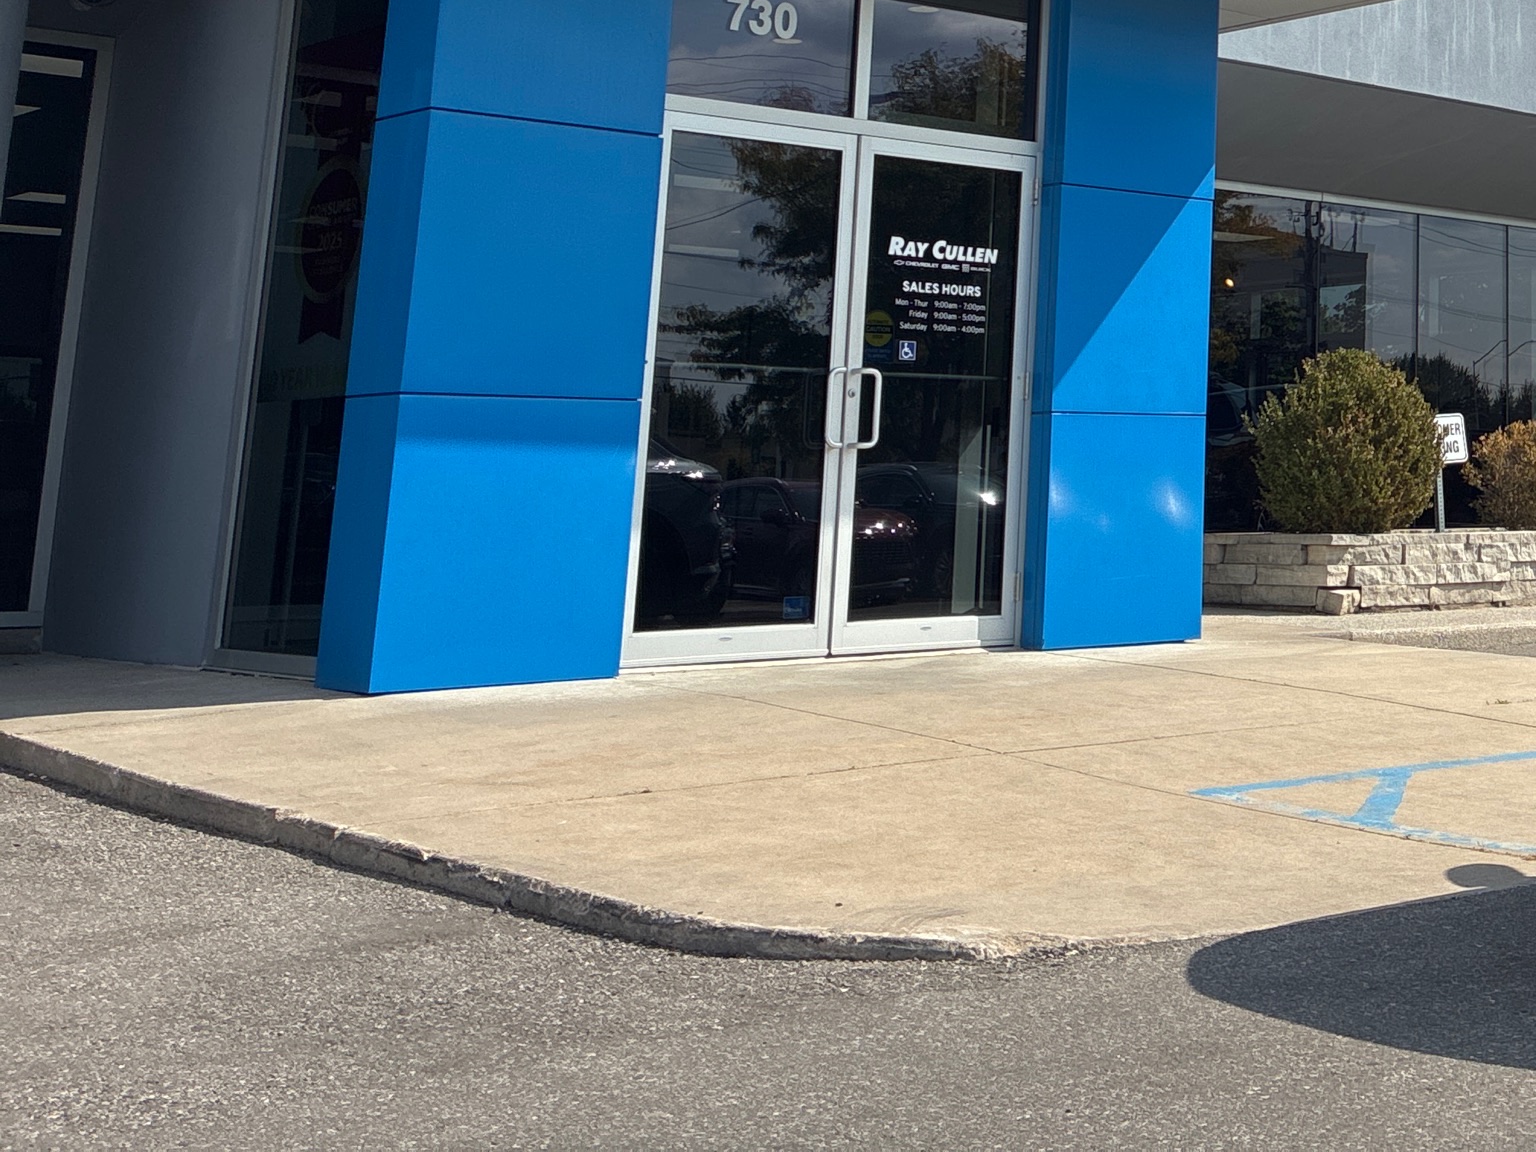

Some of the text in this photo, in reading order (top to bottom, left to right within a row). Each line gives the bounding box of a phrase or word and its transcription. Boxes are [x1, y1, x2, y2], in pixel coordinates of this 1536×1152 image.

[888, 236, 999, 264] RAY CULLEN
[905, 261, 939, 269] CHEVROLET
[941, 263, 960, 271] GMC
[902, 281, 982, 297] SALES HOURS
[895, 298, 909, 306] Mon
[914, 299, 929, 307] Thur
[933, 300, 958, 310] 9:00am
[963, 302, 986, 312] 7:00pm
[908, 310, 929, 319] Friday
[933, 311, 958, 321] 9:00am
[962, 313, 986, 323] 5:00pm
[899, 321, 928, 332] Saturday
[932, 323, 957, 333] 9:00am
[961, 325, 985, 334] 4:00pm
